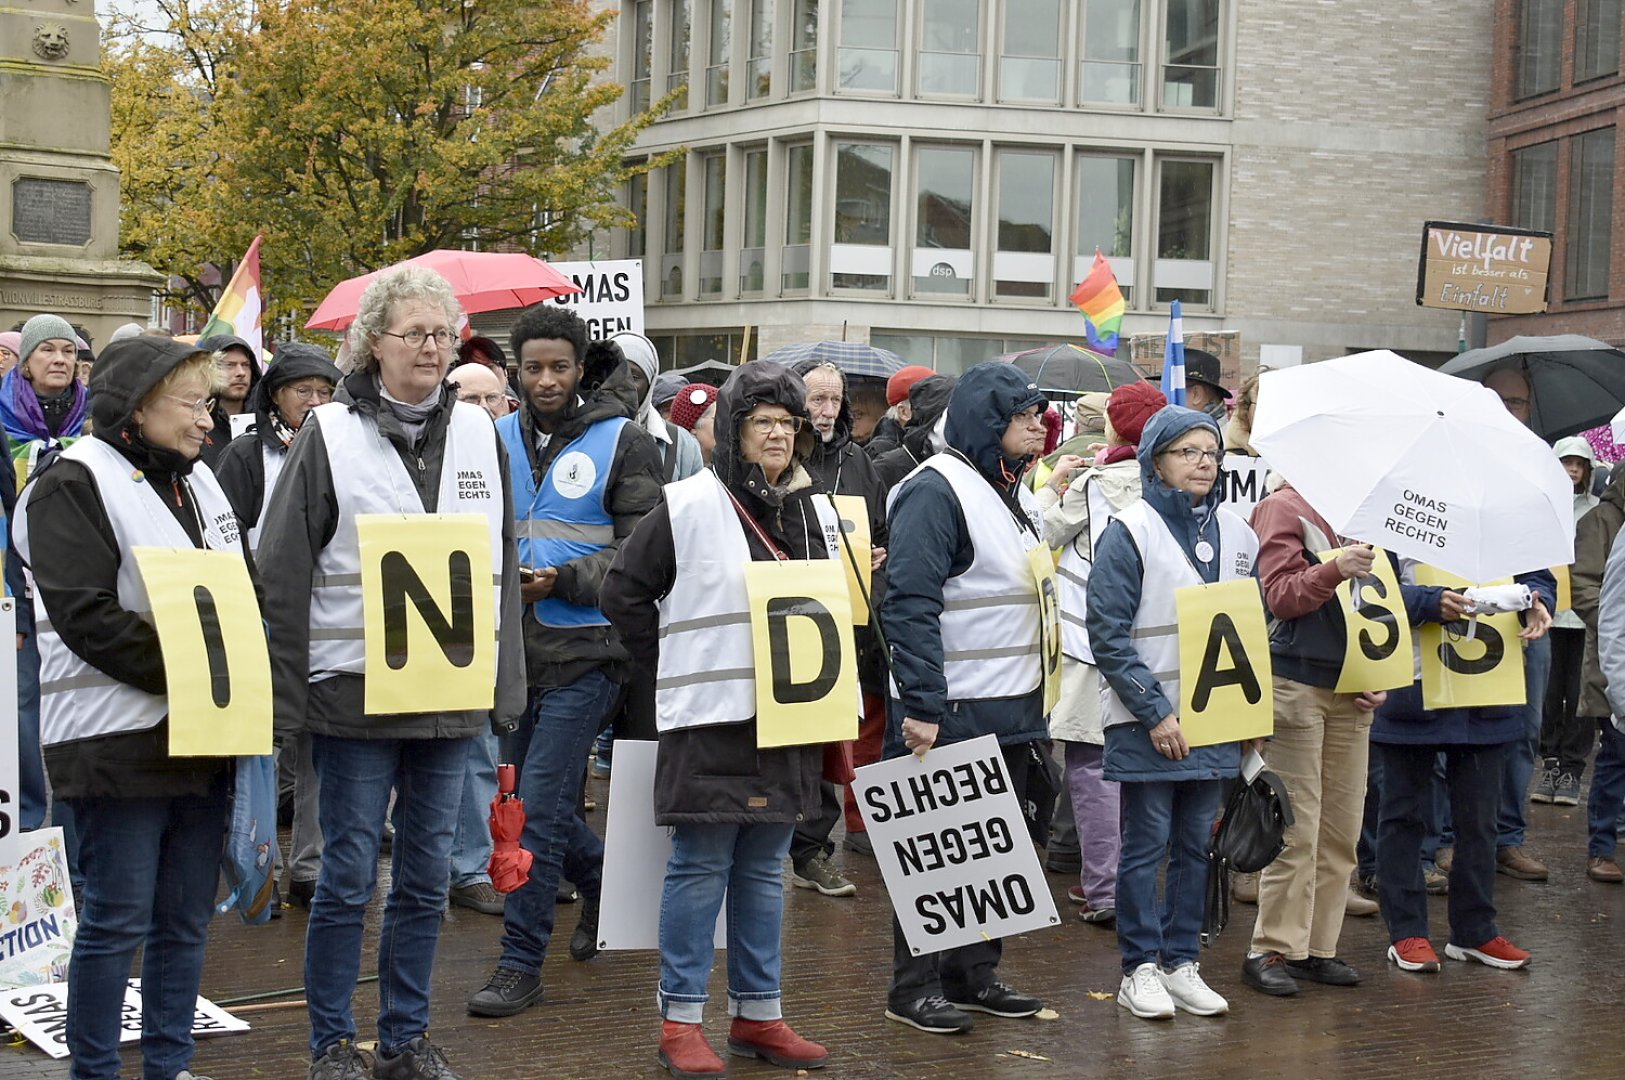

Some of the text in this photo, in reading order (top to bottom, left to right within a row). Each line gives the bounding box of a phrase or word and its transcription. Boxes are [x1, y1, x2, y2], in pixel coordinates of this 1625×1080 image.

[1436, 231, 1534, 271] Vielfalt
[932, 264, 953, 278] dsp
[1452, 263, 1529, 280] ist besser als
[554, 272, 630, 305] MAS
[1440, 283, 1509, 309] Einfalt
[586, 316, 631, 341] GEN
[458, 480, 486, 490] EGEN
[458, 490, 491, 500] ECHTS
[1403, 488, 1447, 513] OMAS
[1384, 517, 1446, 548] RECHTS
[1393, 503, 1448, 531] GEGEN
[380, 550, 474, 670] N
[1349, 572, 1400, 661] S
[193, 584, 231, 709] I
[766, 596, 841, 704] D
[1191, 612, 1262, 713] A
[864, 756, 1008, 823] RECHTS
[892, 817, 1014, 876] GEGEN
[915, 873, 1035, 935] OMAS
